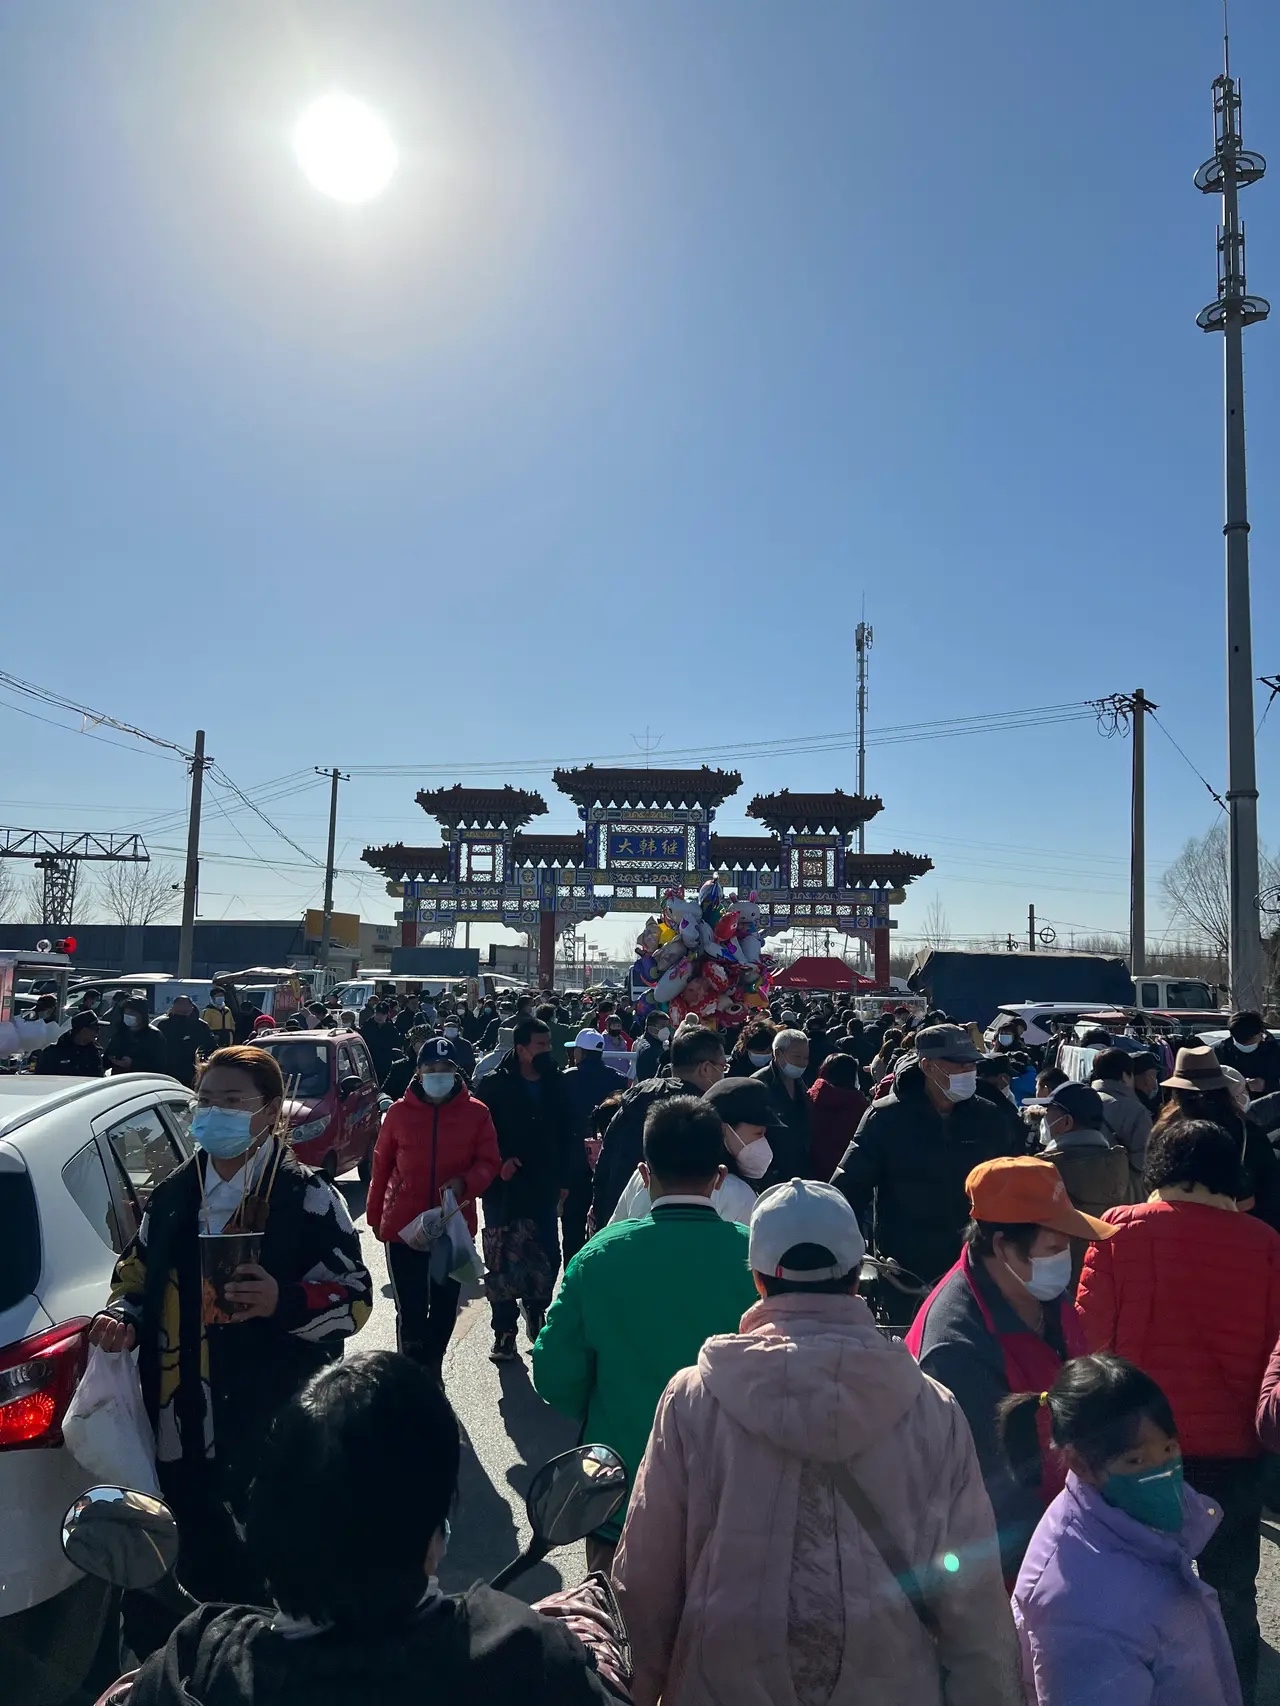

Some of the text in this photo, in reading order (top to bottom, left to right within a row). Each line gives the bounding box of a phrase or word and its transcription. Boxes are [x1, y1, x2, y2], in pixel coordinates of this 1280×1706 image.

[616, 837, 679, 857] 大韩继
[436, 1039, 448, 1056] C
